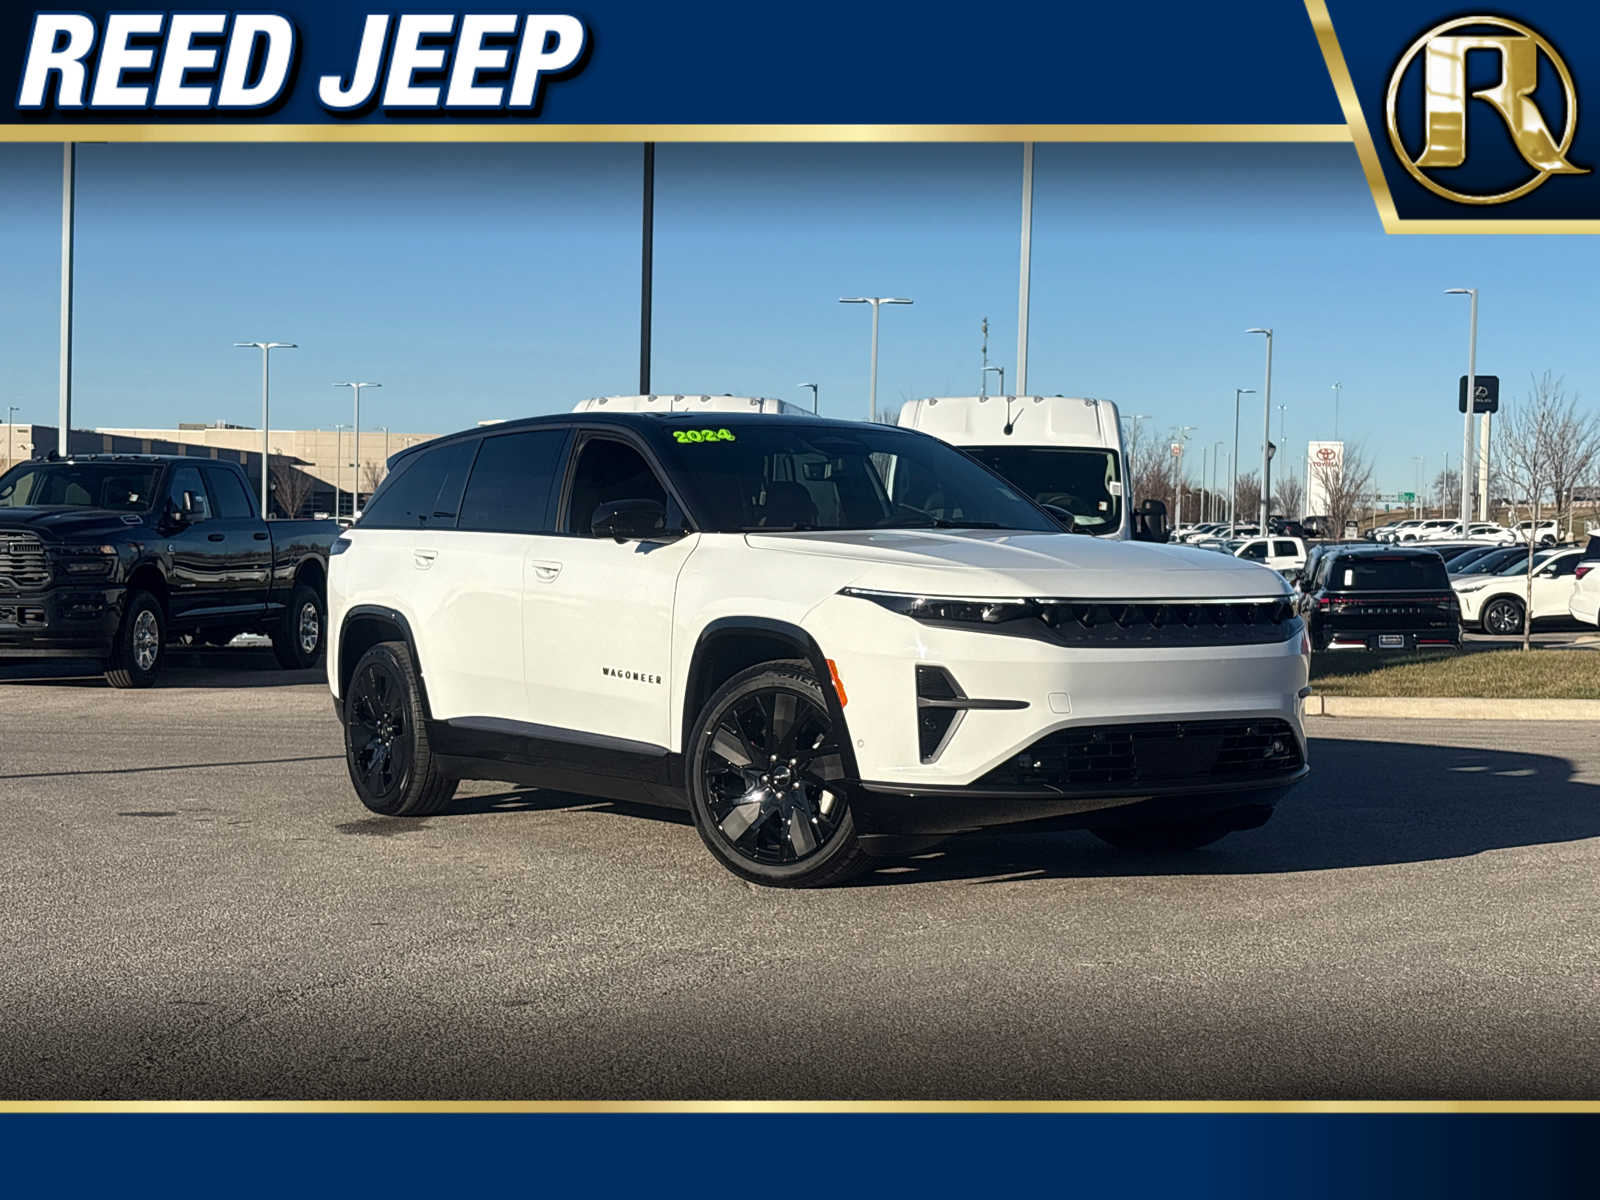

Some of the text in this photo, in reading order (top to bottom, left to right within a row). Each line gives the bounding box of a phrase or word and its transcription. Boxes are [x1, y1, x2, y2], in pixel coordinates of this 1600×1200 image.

[673, 428, 736, 443] 2024
[1360, 607, 1422, 615] INFINITI
[602, 667, 662, 684] WAGONEER
